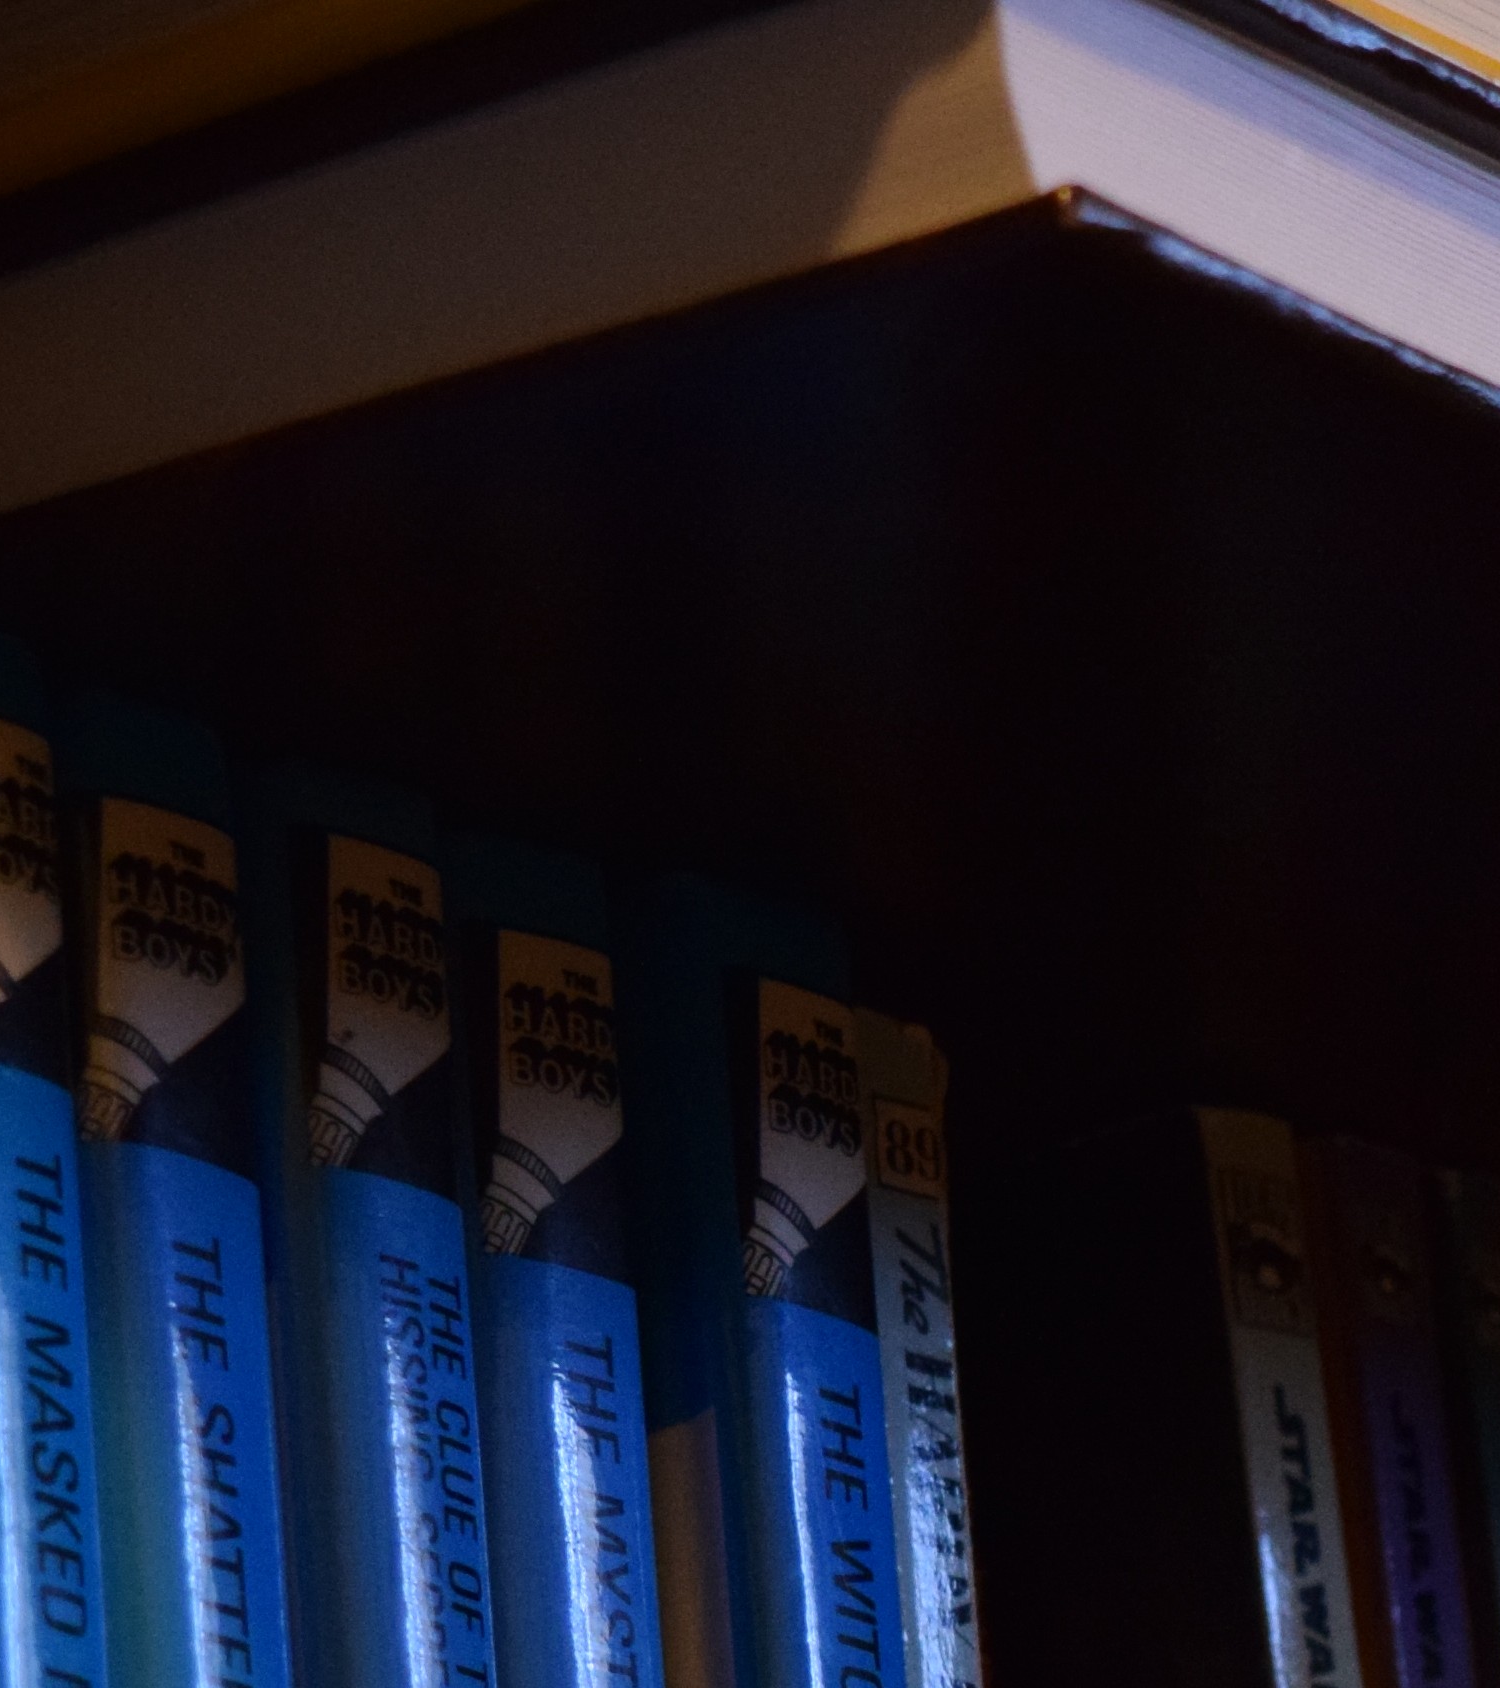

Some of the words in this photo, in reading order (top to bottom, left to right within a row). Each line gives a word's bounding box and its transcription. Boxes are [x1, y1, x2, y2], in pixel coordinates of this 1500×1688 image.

[110, 908, 236, 988] BOYS
[337, 942, 446, 1021] BOYS
[507, 1036, 618, 1110] BOYS
[768, 1083, 862, 1158] BOYS
[885, 1120, 941, 1181] 89
[16, 1154, 70, 1293] THE
[895, 1222, 948, 1336] The
[173, 1237, 230, 1373] THE
[427, 1276, 468, 1381] THE
[562, 1336, 621, 1465] THE
[818, 1385, 869, 1512] THE
[25, 1314, 89, 1638] MASKED
[434, 1398, 480, 1544] CLUE
[1275, 1382, 1322, 1576] STAR
[1388, 1388, 1435, 1581] STAR
[450, 1560, 486, 1639] OF
